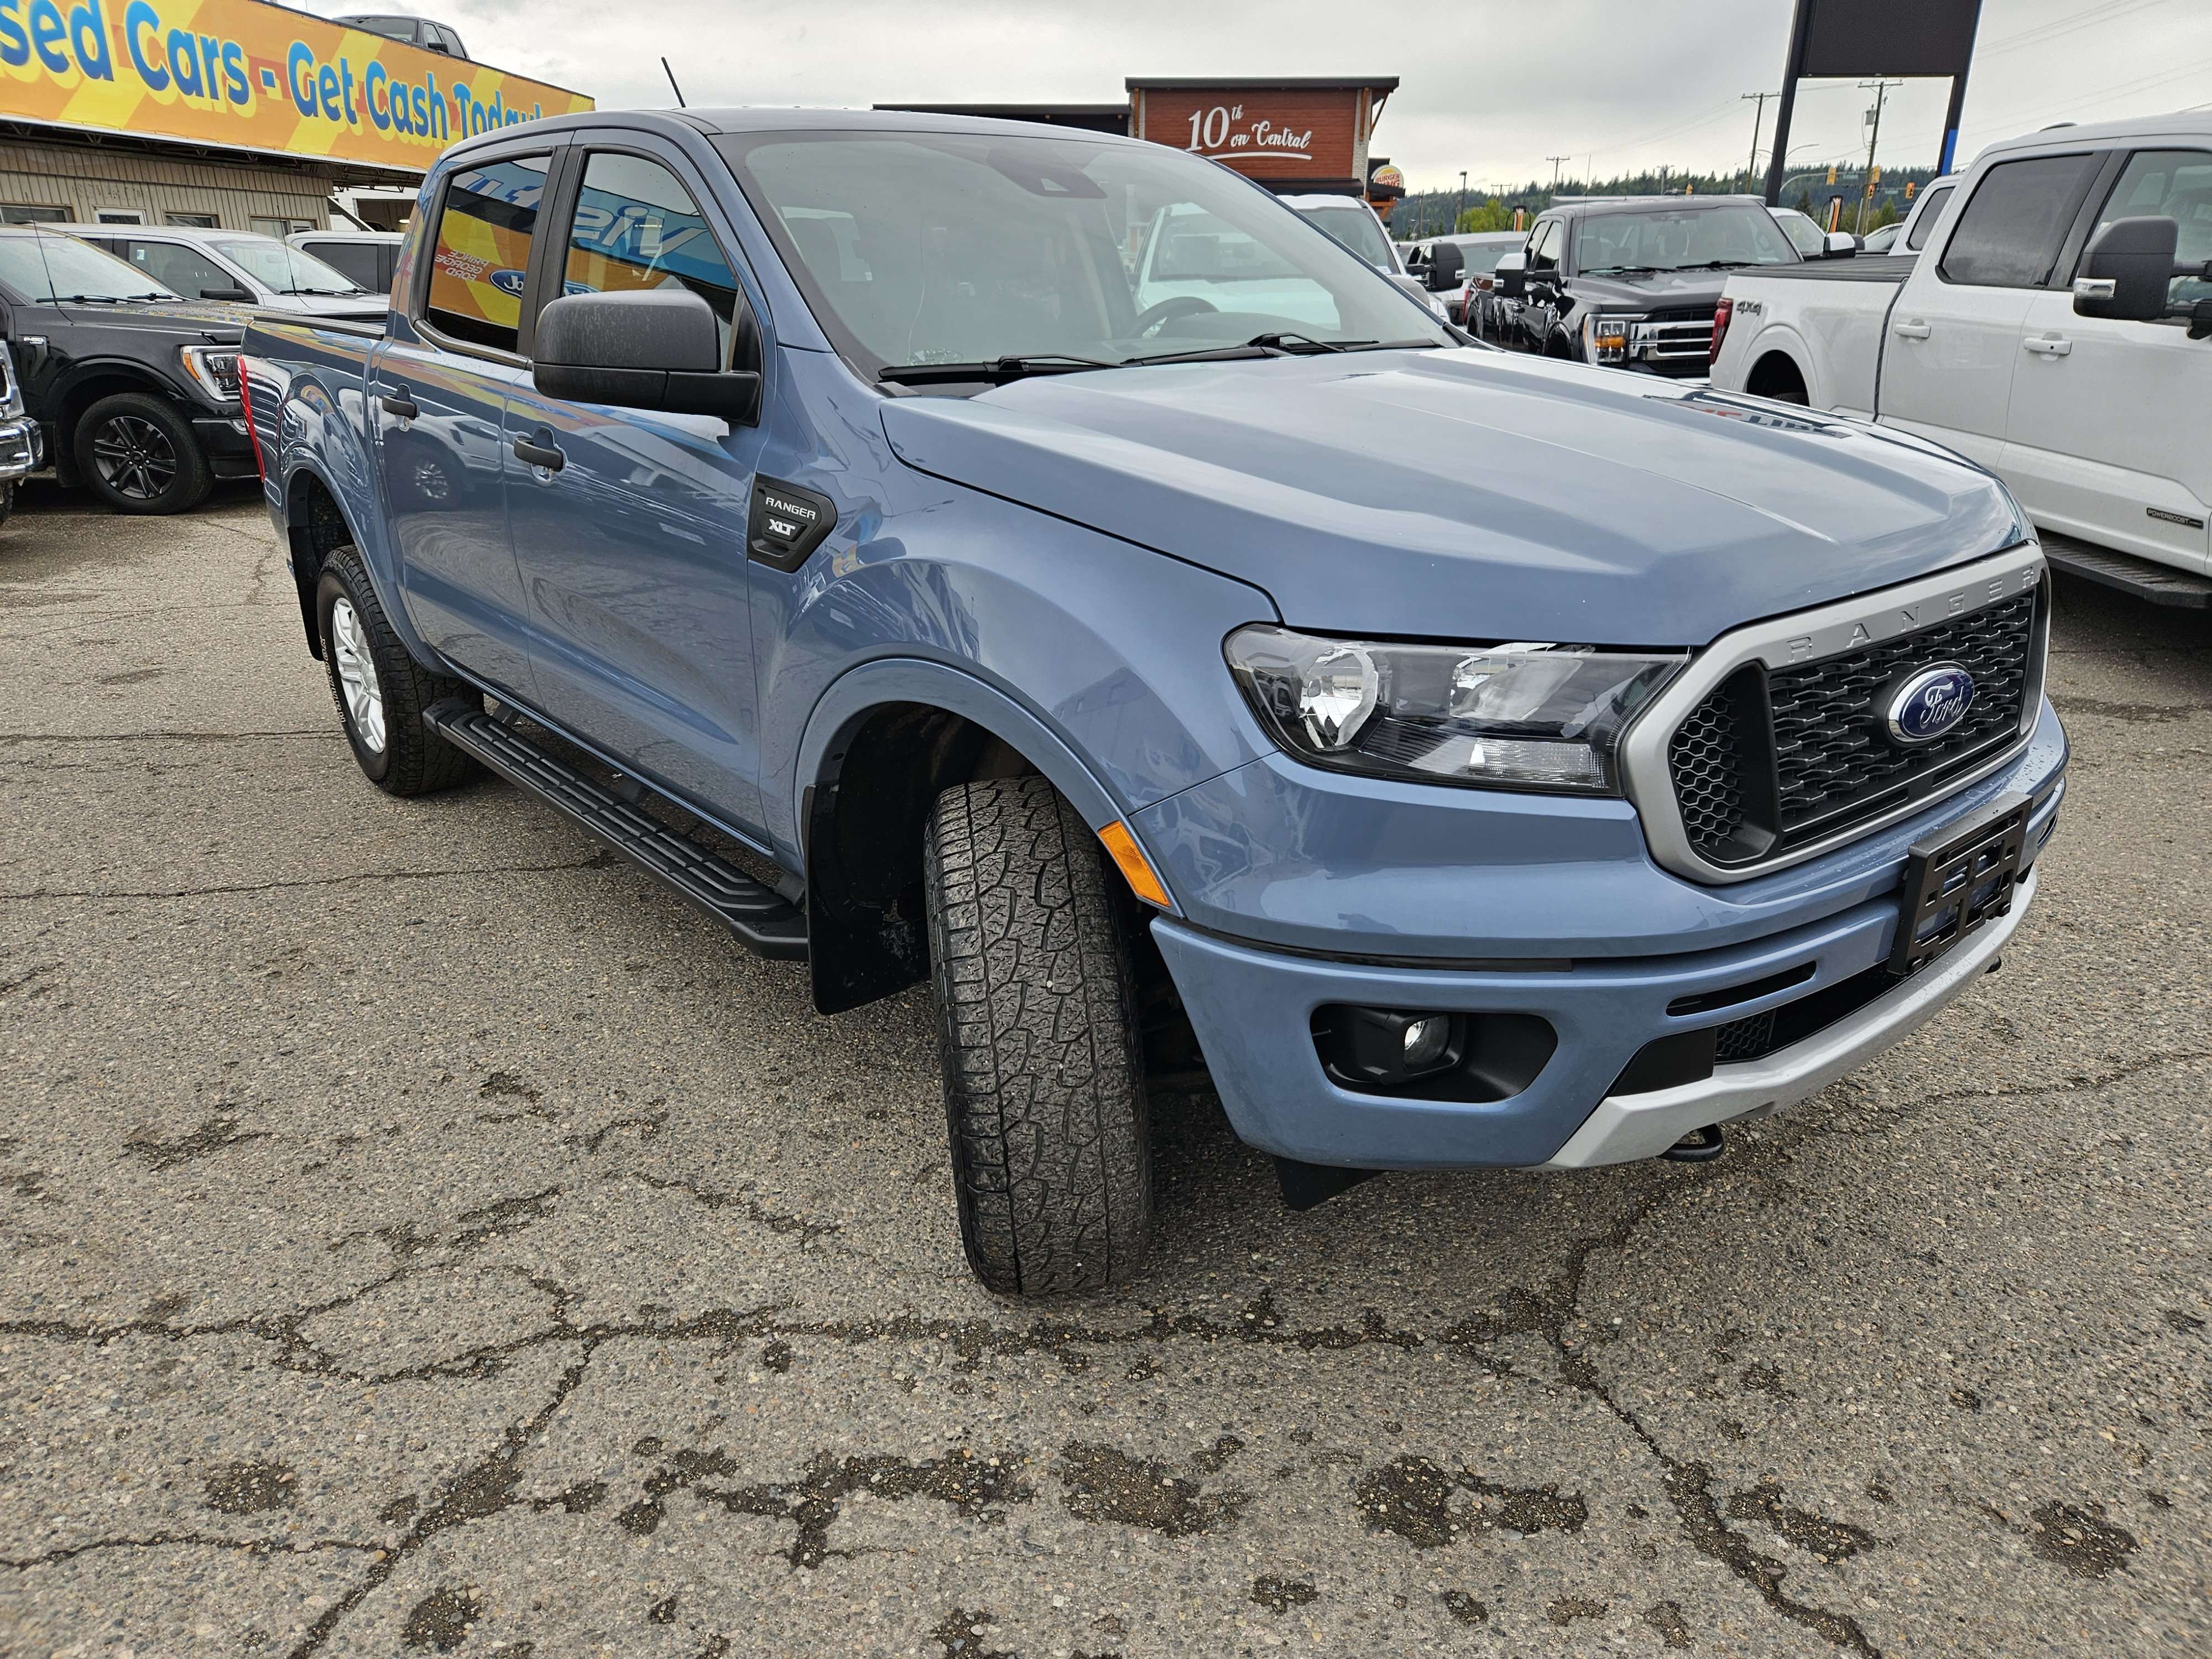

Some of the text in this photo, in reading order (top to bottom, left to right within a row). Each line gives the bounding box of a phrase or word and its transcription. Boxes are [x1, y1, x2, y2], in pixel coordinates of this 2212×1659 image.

[126, 0, 249, 105] Cars
[288, 41, 357, 124] Get
[365, 60, 447, 140] Cash
[1230, 134, 1250, 147] on
[1251, 121, 1312, 149] Central
[765, 497, 816, 520] RANGER
[769, 519, 796, 536] XLT
[1787, 566, 2034, 663] RANGER
[1919, 681, 1965, 729] Ford
